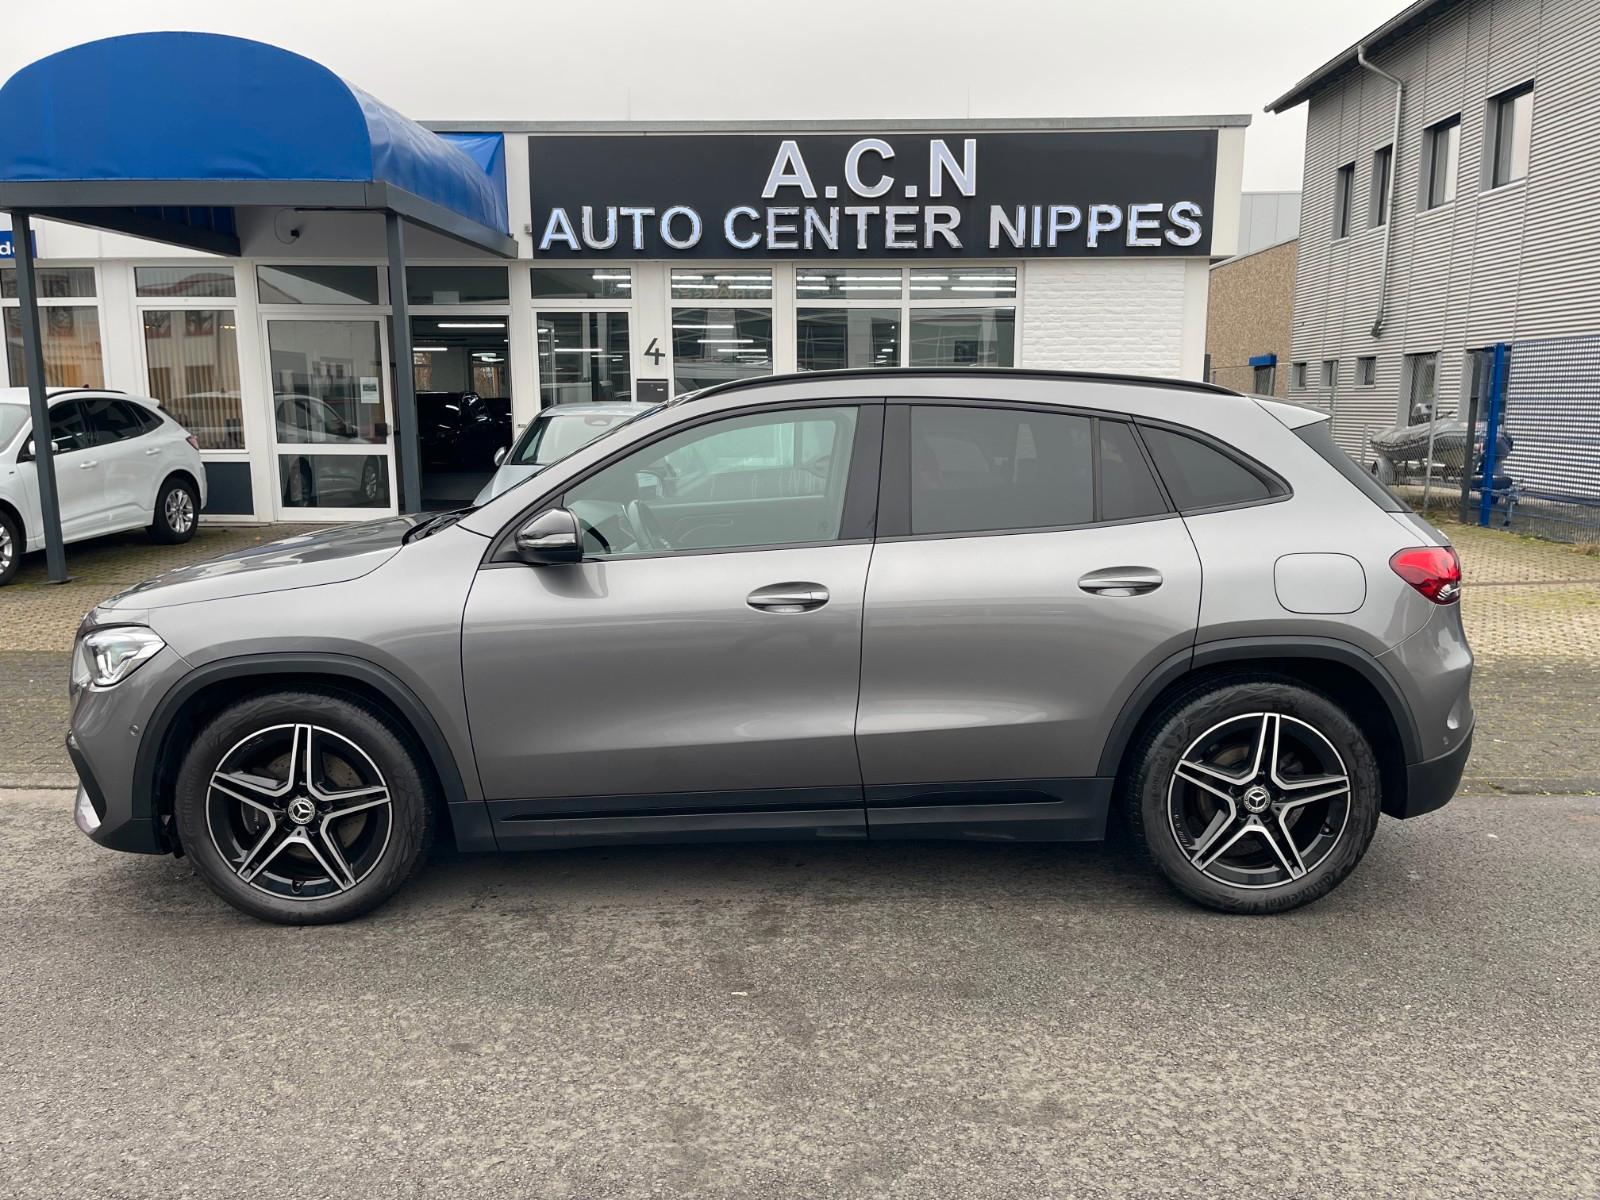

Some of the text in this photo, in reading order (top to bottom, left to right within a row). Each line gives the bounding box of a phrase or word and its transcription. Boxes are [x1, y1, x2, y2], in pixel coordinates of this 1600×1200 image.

[761, 138, 977, 199] A.C.N
[538, 200, 1204, 251] AUTO CENTER NIPPES
[643, 337, 666, 366] 4
